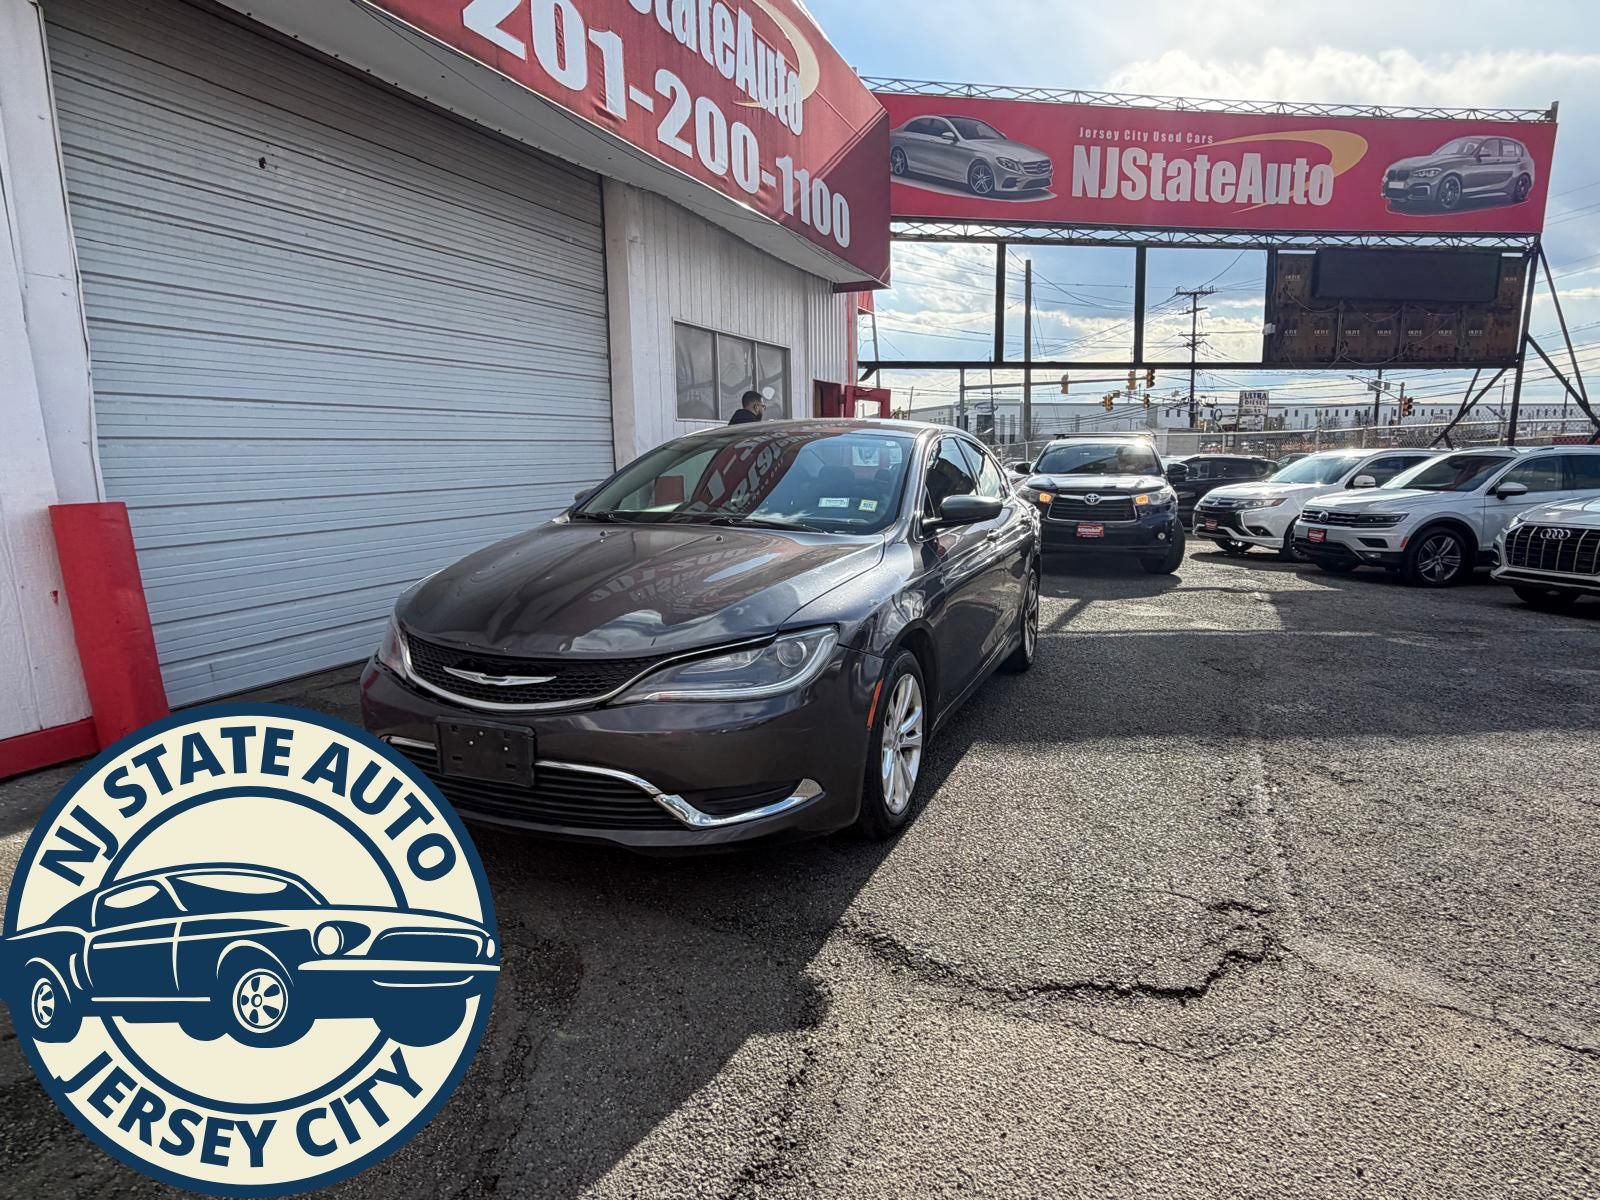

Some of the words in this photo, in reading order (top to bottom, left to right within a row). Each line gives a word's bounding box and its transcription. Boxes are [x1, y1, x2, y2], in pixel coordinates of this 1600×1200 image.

[629, 0, 804, 136] ateAuto
[463, 0, 850, 249] 201-200-1100
[1079, 126, 1119, 141] Jersey
[1124, 129, 1149, 142] City
[1153, 131, 1182, 143] Used
[1186, 132, 1213, 144] Cars
[1071, 144, 1335, 207] NJStateAuto
